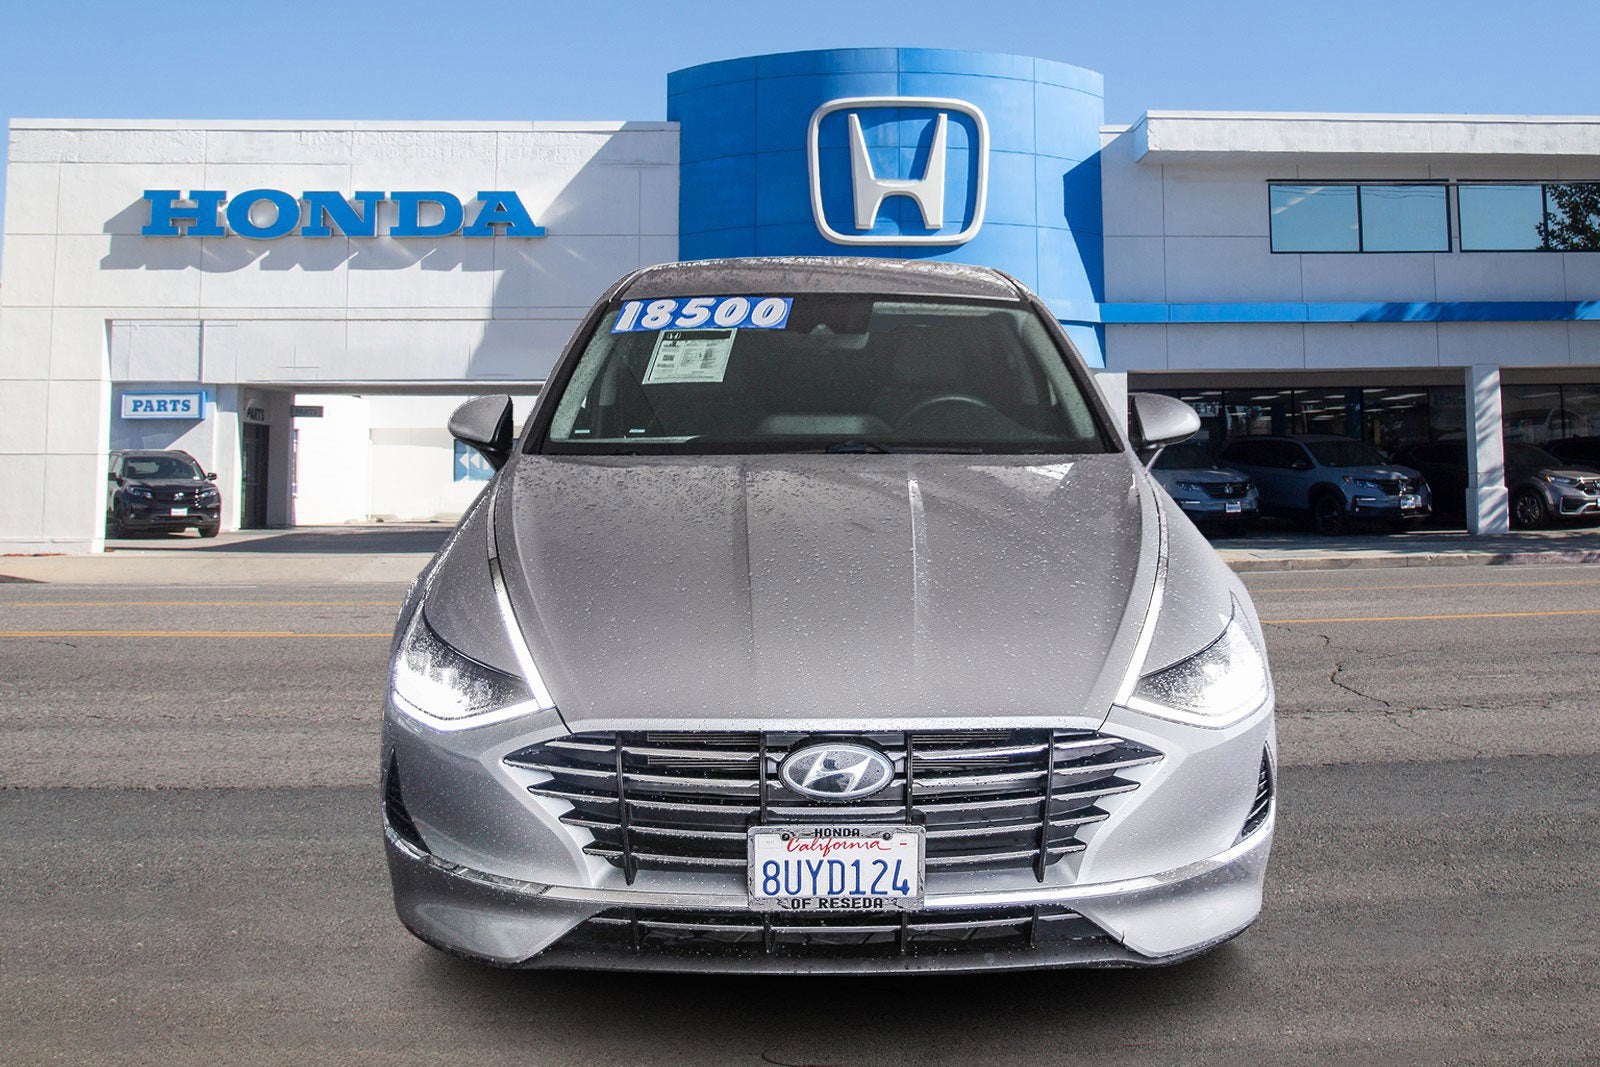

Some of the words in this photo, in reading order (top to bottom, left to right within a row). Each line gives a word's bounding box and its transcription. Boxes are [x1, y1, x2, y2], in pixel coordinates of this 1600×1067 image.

[141, 189, 547, 238] HONDA
[615, 297, 788, 330] 18500
[132, 400, 192, 412] PARTS
[814, 828, 860, 837] HONDA
[786, 838, 891, 857] California
[762, 859, 910, 896] 8UYD124
[791, 898, 811, 909] OF
[819, 898, 883, 909] RESEDA
